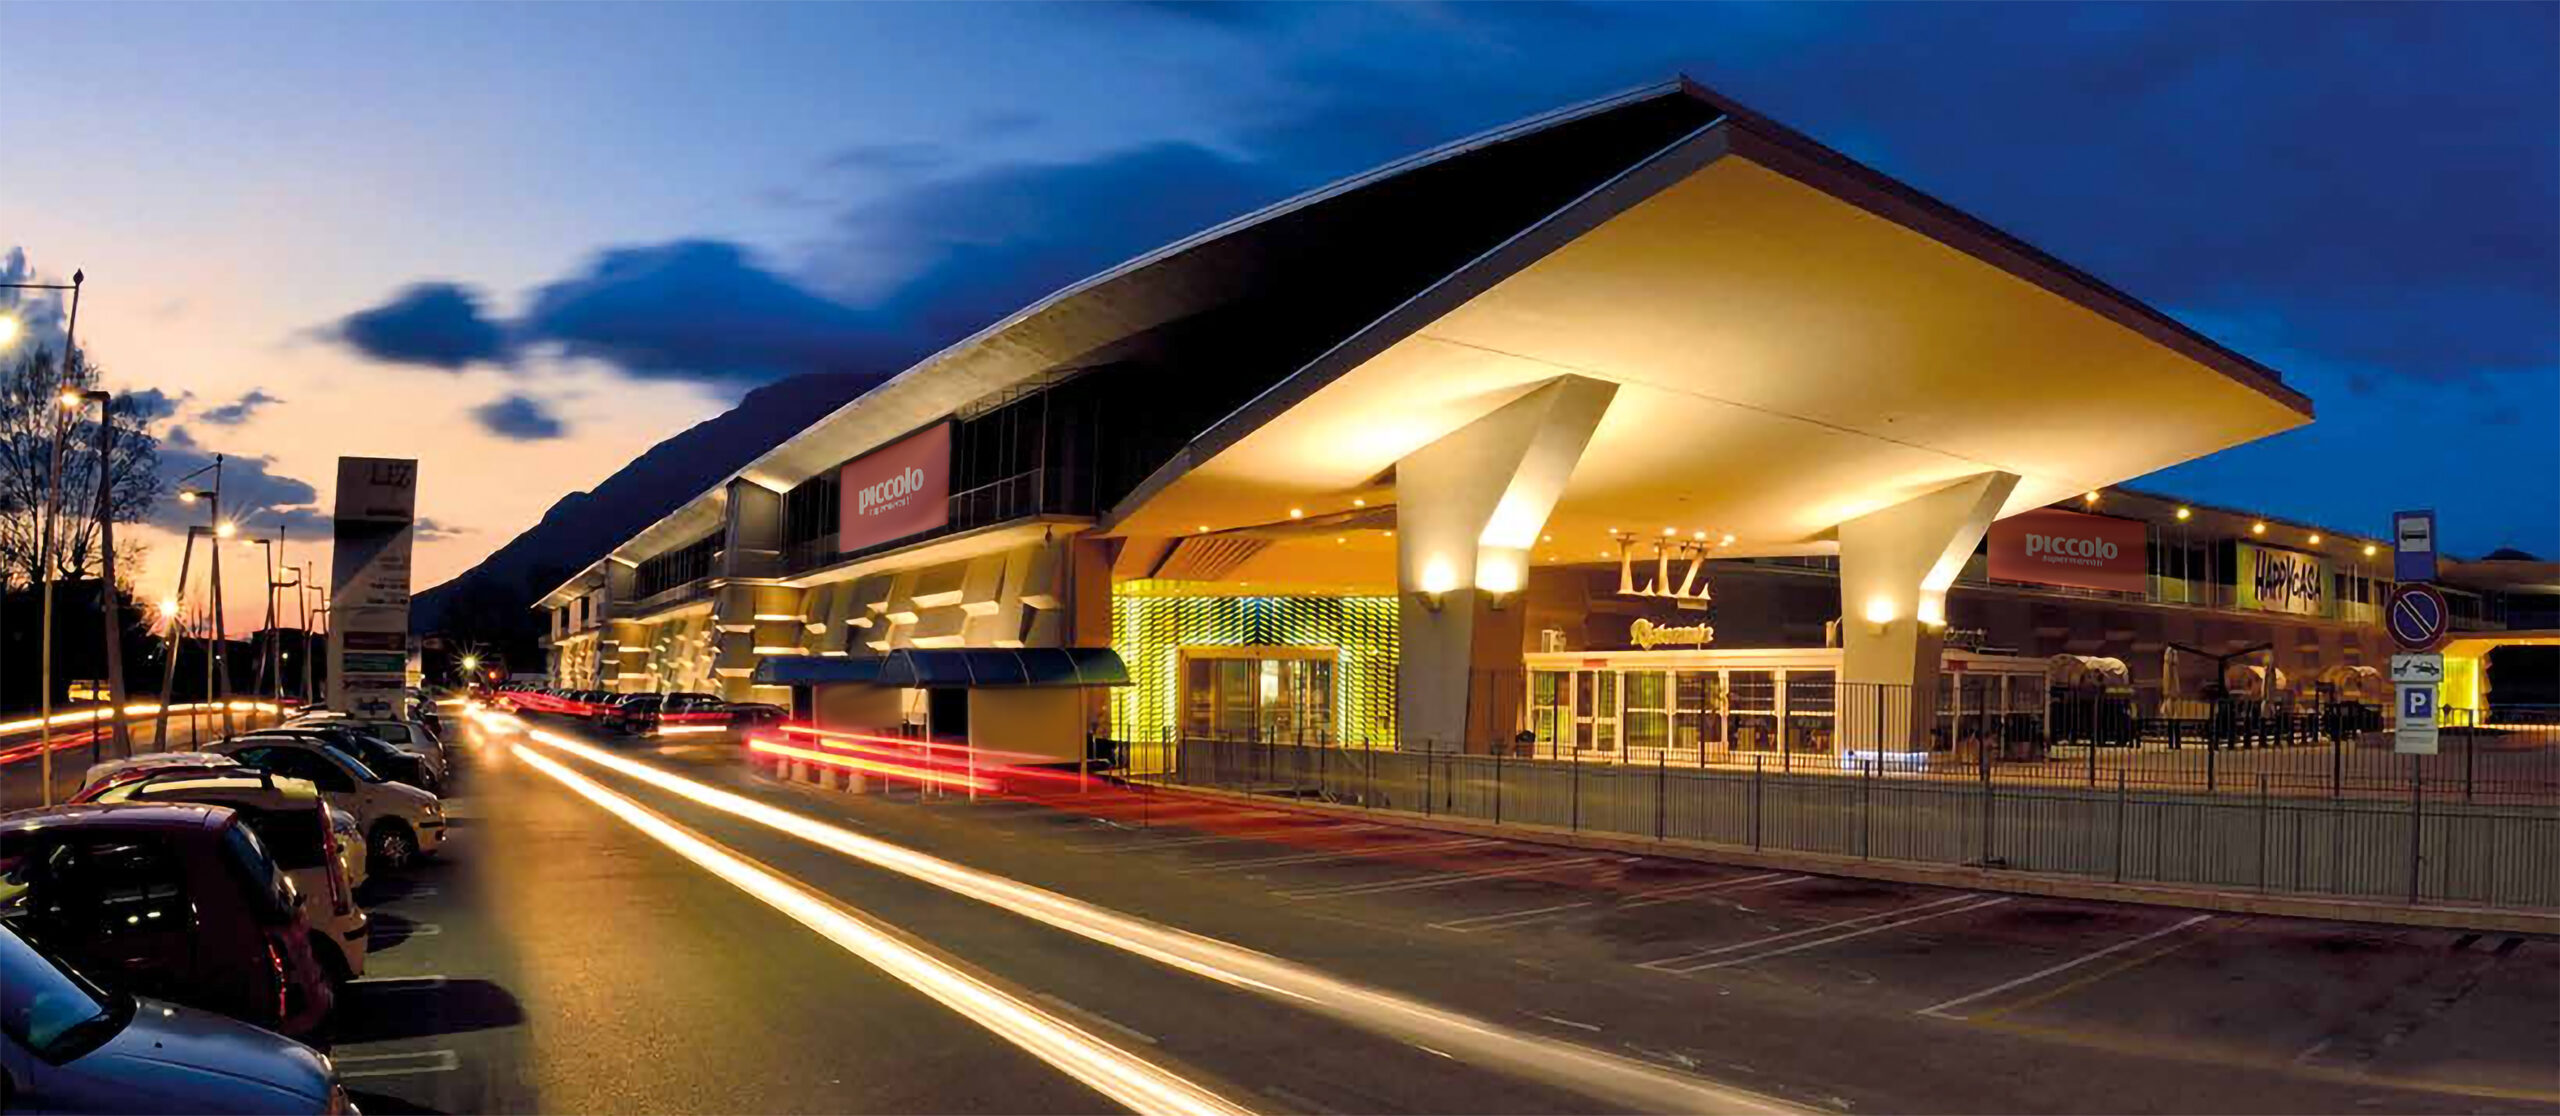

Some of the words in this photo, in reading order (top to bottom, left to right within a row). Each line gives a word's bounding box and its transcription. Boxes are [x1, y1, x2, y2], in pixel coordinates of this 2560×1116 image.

[858, 466, 924, 515] piccolo
[2025, 533, 2118, 560] piccolo
[1616, 536, 1712, 600] LIZ
[2410, 692, 2426, 714] P
